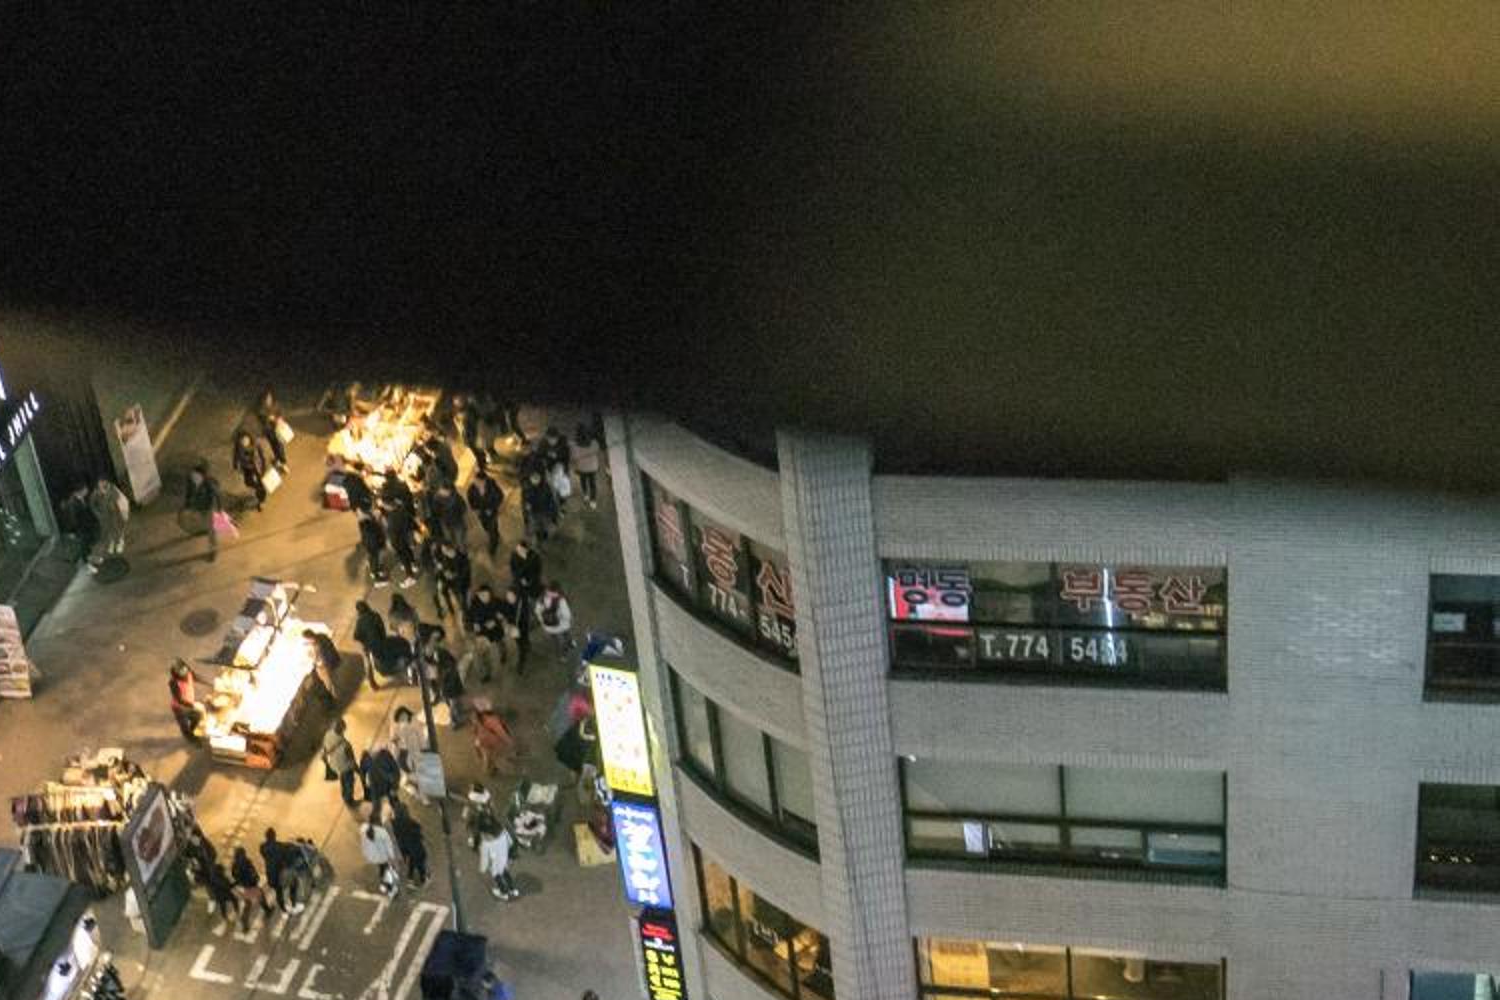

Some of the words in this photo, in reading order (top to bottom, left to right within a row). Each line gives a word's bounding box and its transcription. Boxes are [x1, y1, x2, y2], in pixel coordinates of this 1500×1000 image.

[7, 392, 39, 446] JHILL
[897, 569, 973, 607] 명동
[1060, 570, 1206, 615] 부동산
